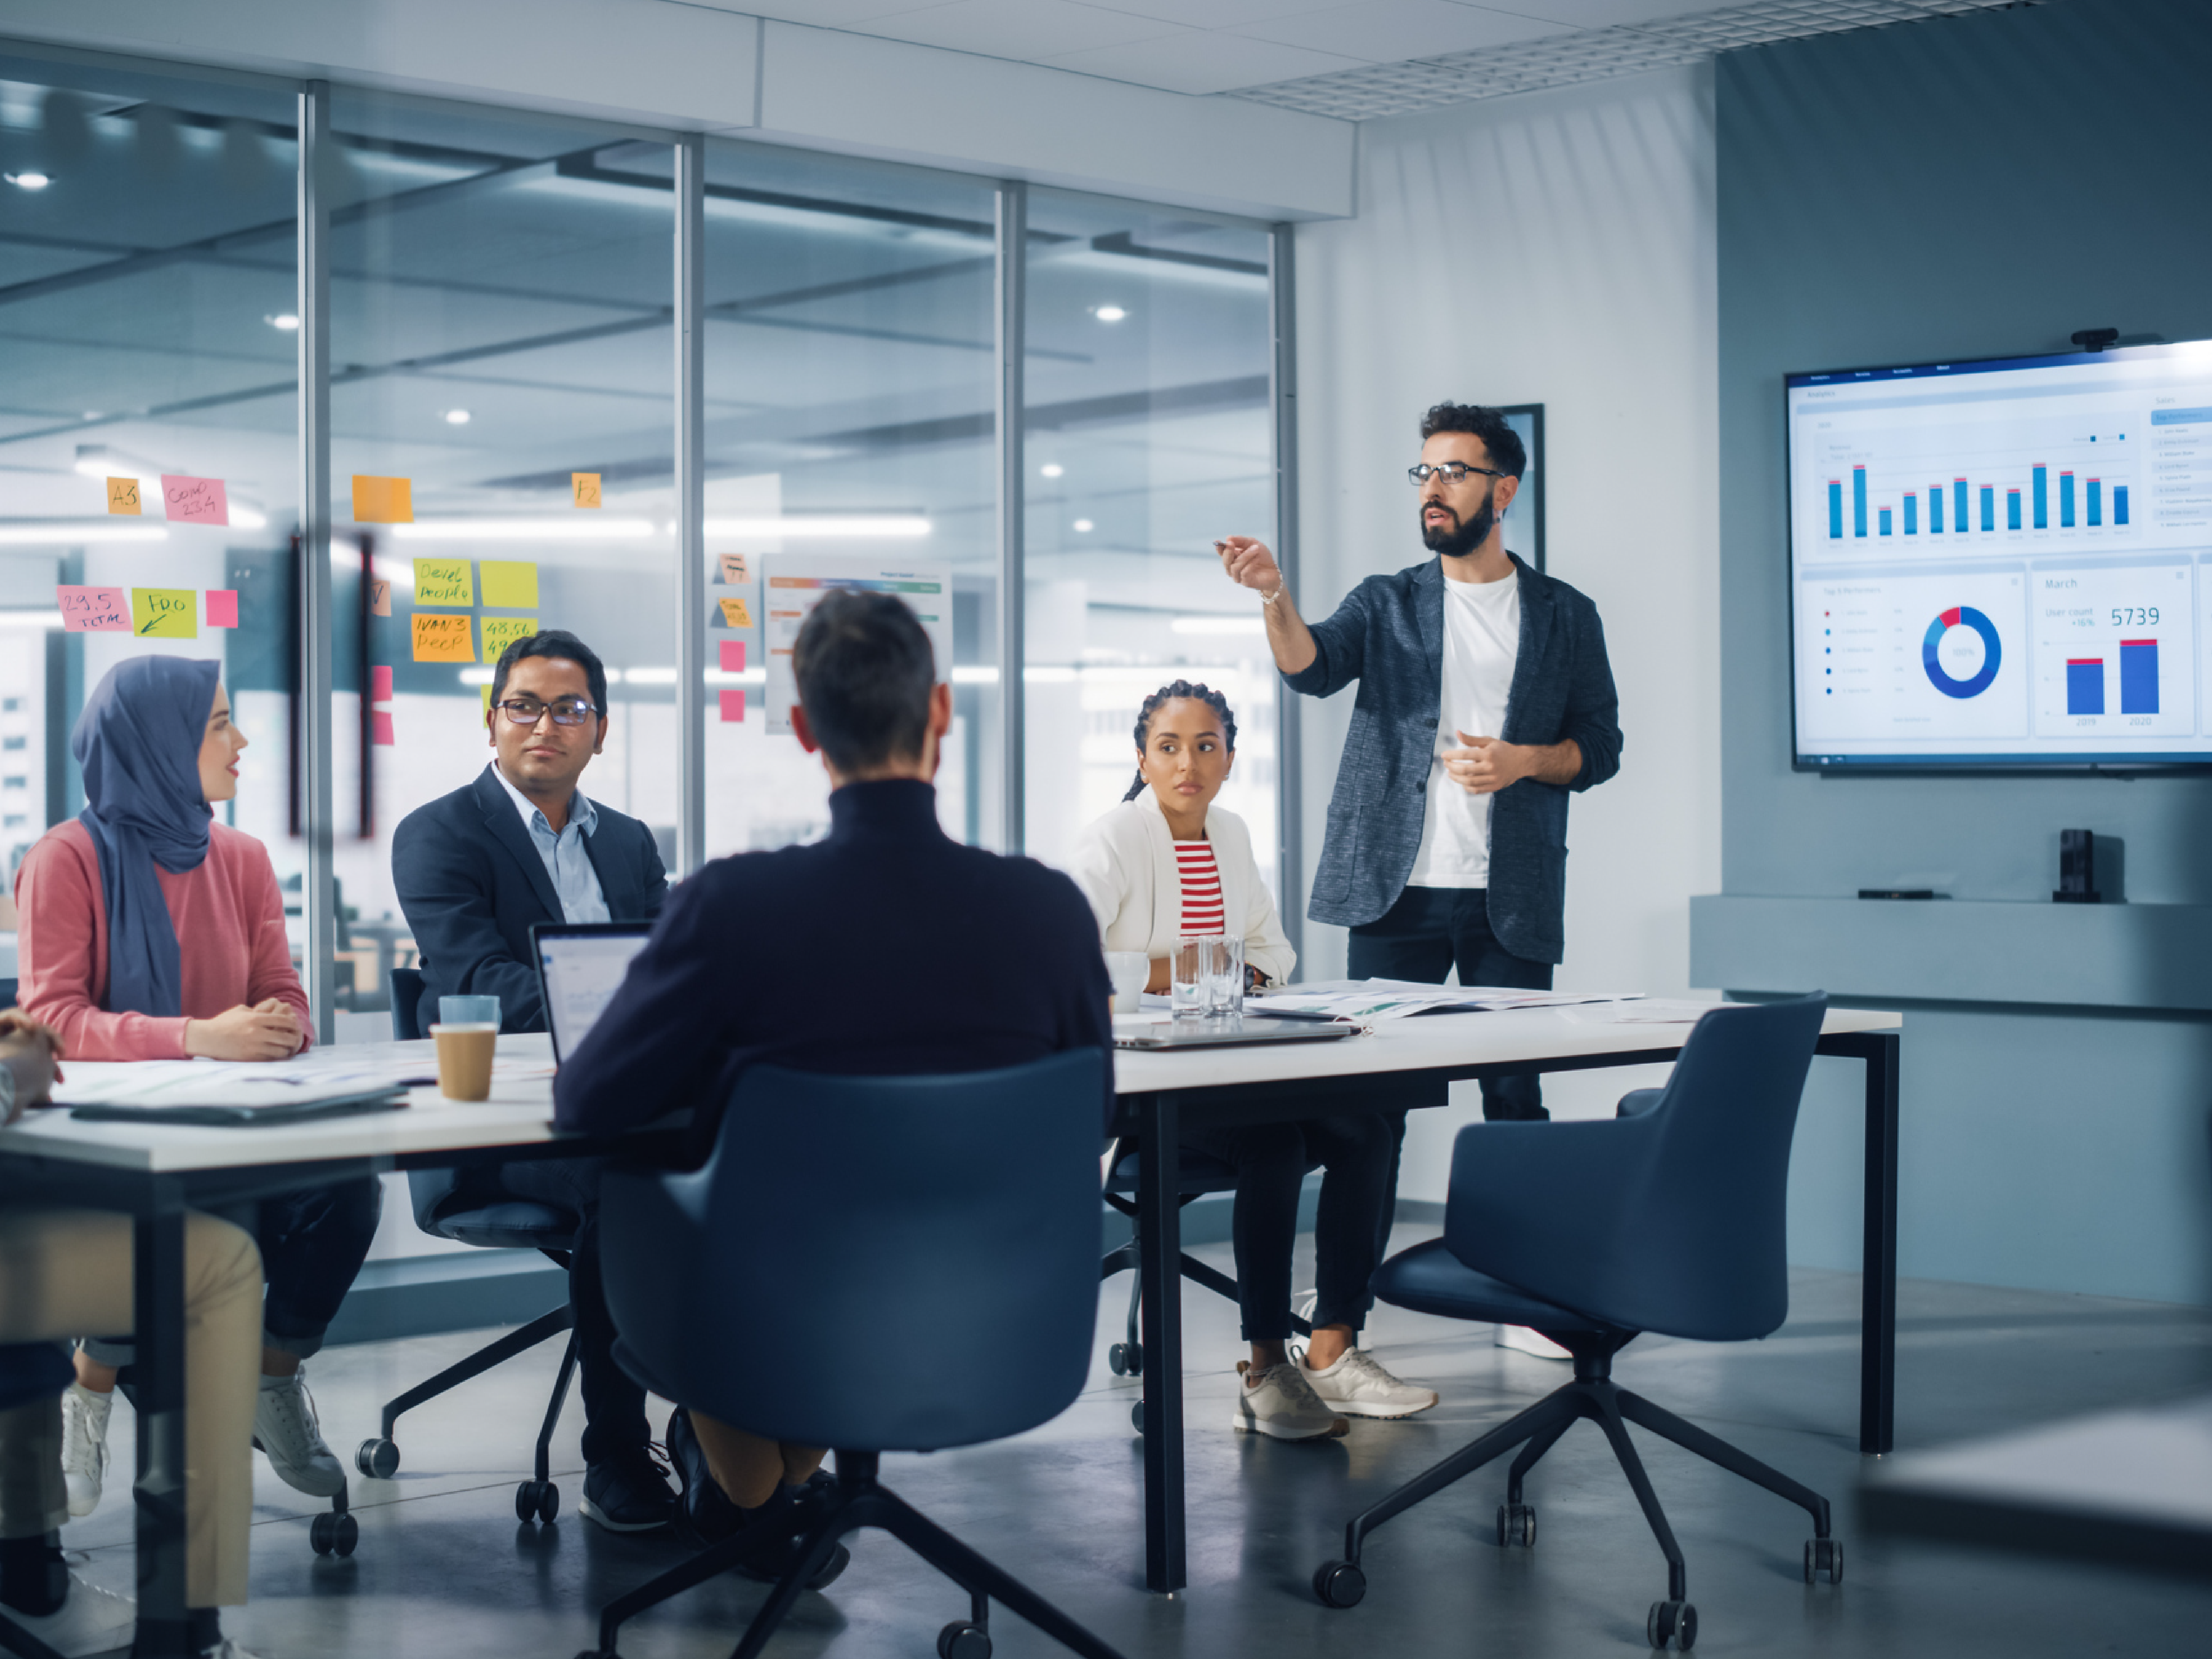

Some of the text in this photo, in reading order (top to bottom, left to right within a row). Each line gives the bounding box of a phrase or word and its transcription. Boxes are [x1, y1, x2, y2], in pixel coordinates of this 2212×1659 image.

[112, 485, 137, 505] A3
[577, 480, 600, 504] F2
[2046, 578, 2078, 589] March
[64, 593, 111, 611] 29.5
[2046, 607, 2160, 626] User count 5739
[2076, 717, 2098, 726] 2019
[2129, 716, 2152, 726] 2020
